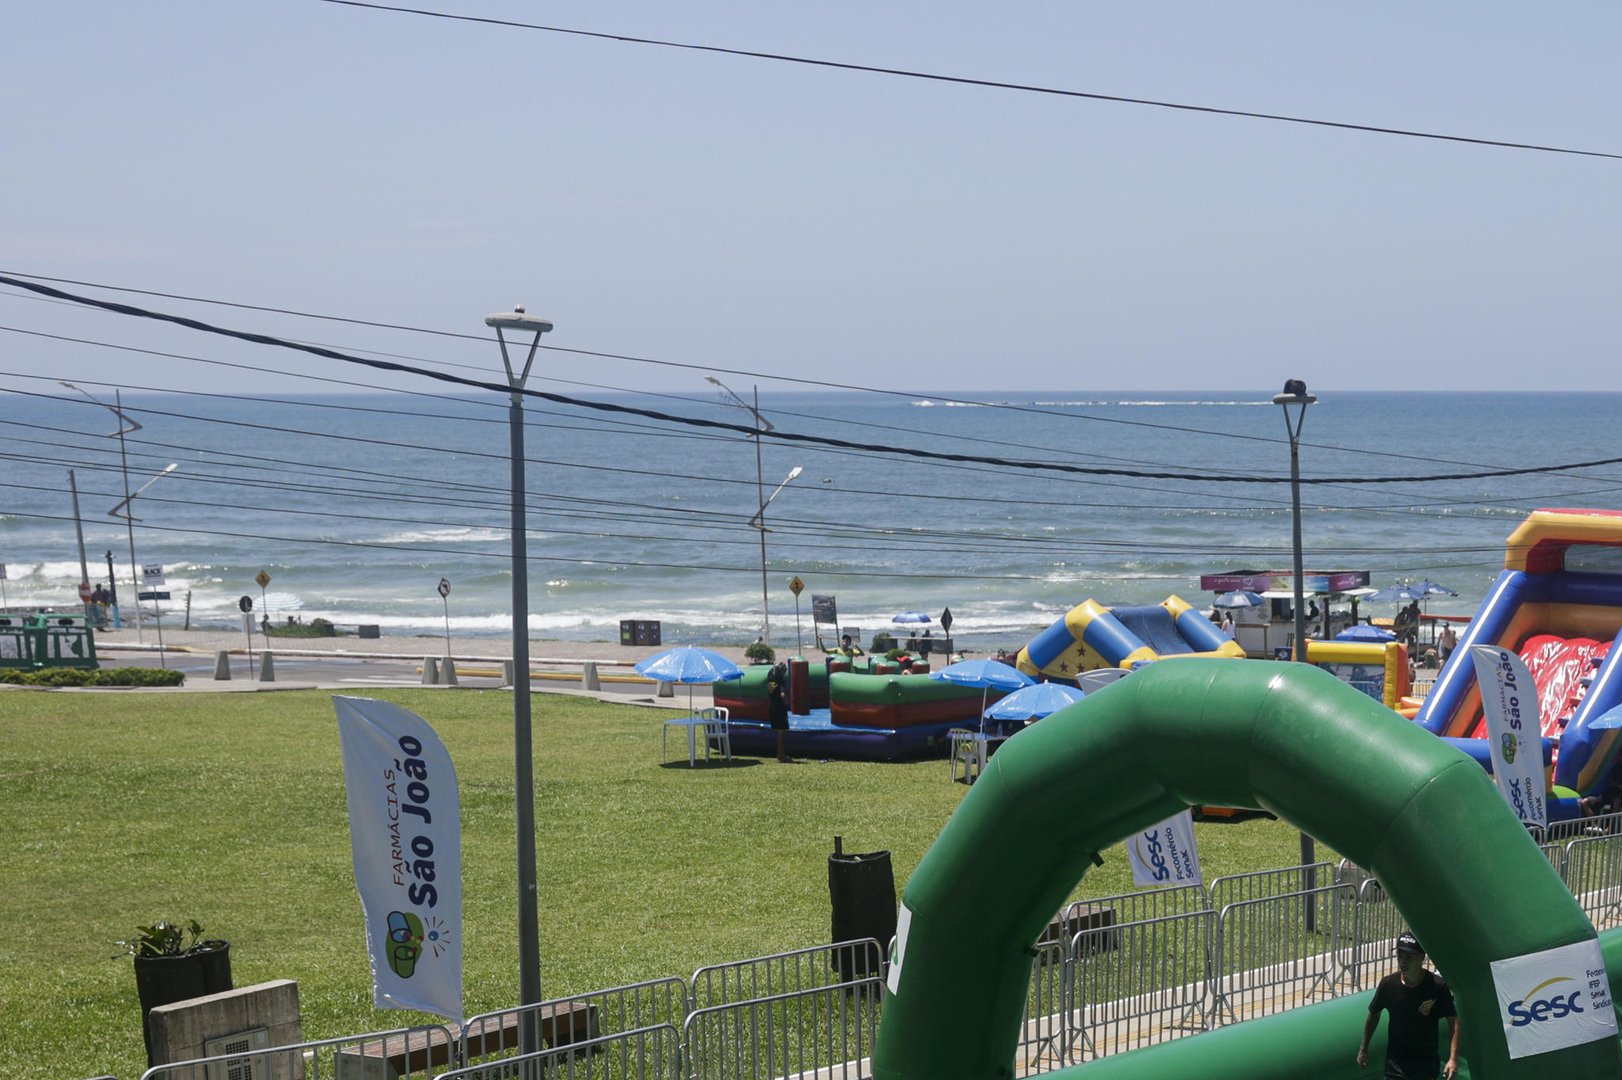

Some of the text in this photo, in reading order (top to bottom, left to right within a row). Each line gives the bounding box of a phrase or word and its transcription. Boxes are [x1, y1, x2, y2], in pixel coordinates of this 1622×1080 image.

[1499, 651, 1522, 731] São João
[384, 769, 404, 886] FARMÁCIAS
[394, 735, 438, 908] São João
[1144, 830, 1170, 881] Sesc
[1508, 991, 1584, 1027] Sesc
